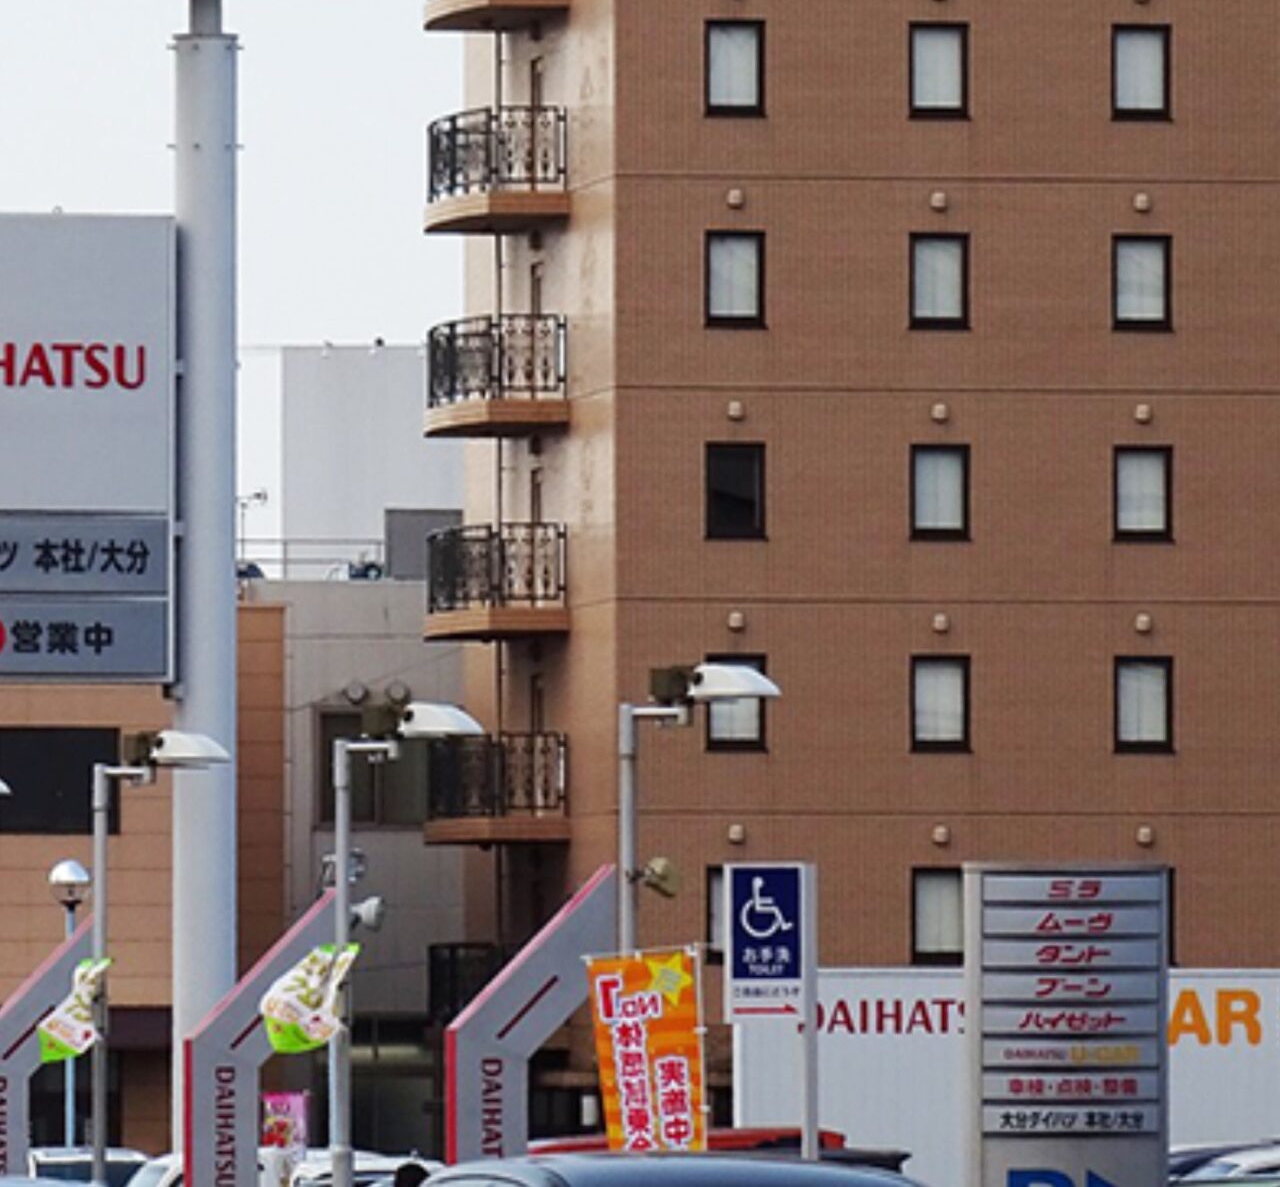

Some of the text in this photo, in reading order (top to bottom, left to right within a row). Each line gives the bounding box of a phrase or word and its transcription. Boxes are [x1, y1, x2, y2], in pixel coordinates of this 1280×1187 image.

[33, 539, 150, 575] 本社/大分
[1048, 879, 1102, 898] ミラ
[1036, 912, 1114, 933] ムーヴ
[1035, 945, 1111, 963] タント
[797, 999, 965, 1034] AIHAT
[1019, 1011, 1127, 1031] ハイゼット
